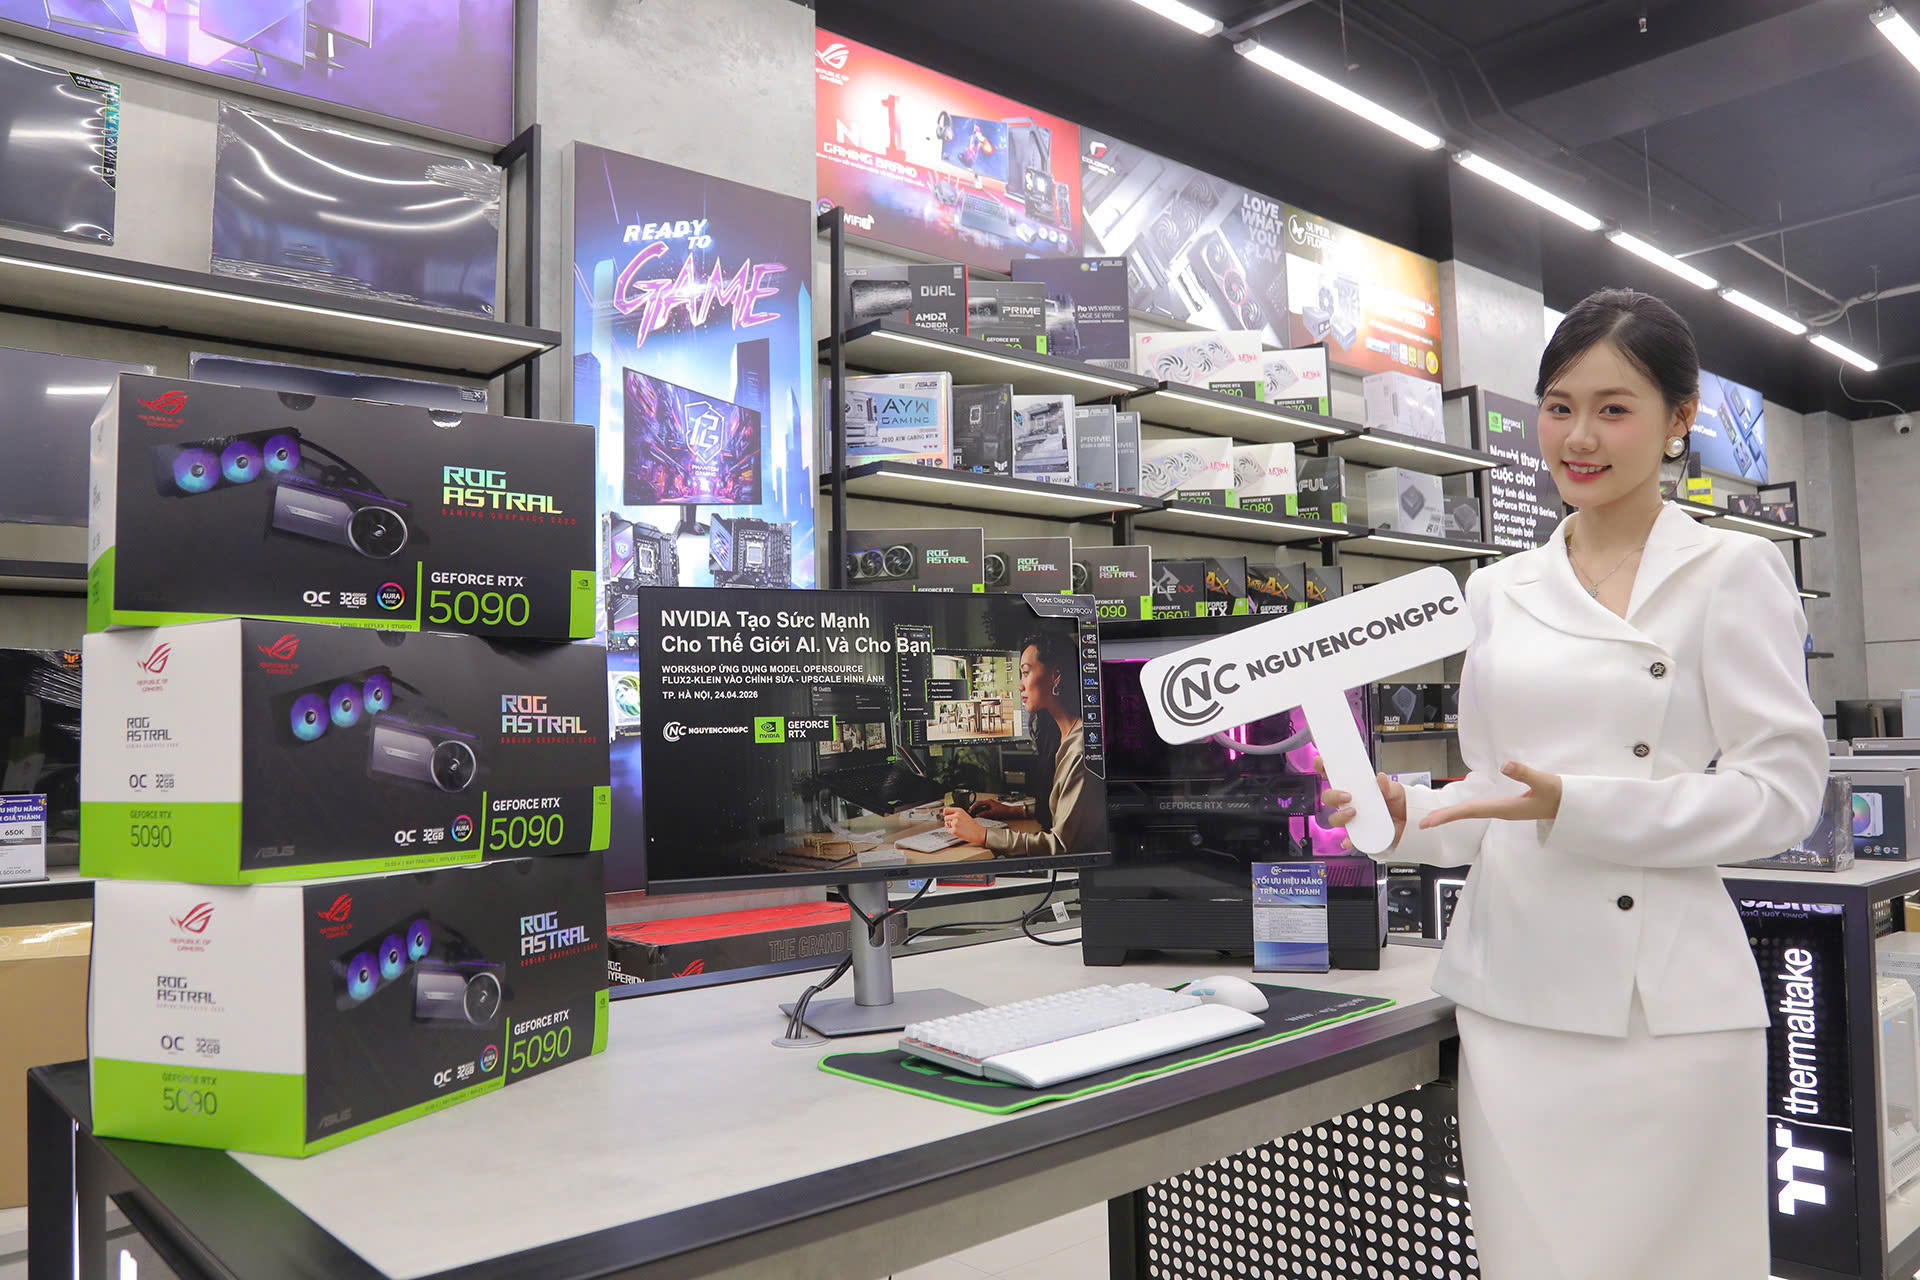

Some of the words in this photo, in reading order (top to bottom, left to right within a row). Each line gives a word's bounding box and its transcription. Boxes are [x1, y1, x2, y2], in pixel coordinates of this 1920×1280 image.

[823, 142, 873, 166] GAMING
[876, 156, 918, 179] BRAND
[1243, 193, 1279, 219] LOVE
[1240, 208, 1284, 235] WHAT
[623, 219, 708, 243] READY
[1249, 225, 1278, 247] YOU
[1305, 221, 1330, 239] SUPER
[687, 235, 712, 250] TO
[1246, 240, 1282, 264] PLAY
[613, 241, 788, 349] GAME
[920, 285, 956, 297] DUAL
[915, 313, 938, 322] AMD
[1002, 306, 1041, 315] PRIME
[882, 398, 929, 414] AYW
[882, 417, 930, 425] GAMING
[1080, 435, 1111, 443] PRIME
[1520, 452, 1540, 472] thay
[443, 465, 507, 490] ROG
[1491, 467, 1514, 485] cuộc
[1515, 470, 1536, 487] chơi
[442, 486, 564, 515] ASTRAL
[1492, 497, 1518, 511] GeForce
[1518, 502, 1531, 513] RTX
[442, 508, 484, 519] GAMING
[491, 511, 544, 523] GRAPHICS
[550, 516, 577, 526] CARD
[926, 549, 949, 557] ROG
[926, 556, 969, 565] ASTRAL
[1017, 557, 1039, 565] ROG
[1017, 564, 1058, 572] ASTRAL
[431, 572, 494, 588] GEFORCE
[498, 574, 524, 587] RTX
[303, 590, 331, 605] OC
[339, 592, 367, 606] 32GB
[1035, 596, 1052, 604] ProArt
[1053, 597, 1075, 605] Display
[428, 590, 530, 627] 5090
[1260, 604, 1288, 612] GEFORCE
[661, 610, 732, 628] NVIDIA
[737, 611, 771, 632] Tạo
[776, 611, 815, 628] Sức
[820, 612, 870, 632] Mạnh
[661, 636, 702, 653] Cho
[707, 633, 744, 653] Thế
[749, 634, 790, 653] Giới
[796, 637, 821, 653] AI.
[826, 635, 850, 653] Và
[854, 636, 891, 653] Cho
[896, 637, 936, 657] Bạn.
[1245, 596, 1459, 682] NGUYENCONGPC
[661, 665, 717, 674] WORKSHOP
[719, 663, 740, 674] ỨNG
[742, 665, 768, 676] DỤNG
[769, 665, 801, 673] MODEL
[803, 665, 863, 673] OPENSOURCE
[662, 675, 722, 684] FLUX2-KLEIN
[723, 673, 743, 684] VÀO
[745, 673, 773, 684] CHỈNH
[775, 673, 794, 684] SỬA
[801, 675, 842, 684] UPSCALE
[843, 673, 865, 683] HÌNH
[866, 673, 885, 683] ẢNH
[662, 691, 676, 700] TP.
[678, 689, 692, 700] HÀ
[694, 689, 714, 701] NỘI,
[715, 691, 758, 699] 24.04.2026
[501, 694, 548, 714] ROG
[126, 717, 150, 729] ROG
[501, 716, 588, 734] ASTRAL
[688, 726, 748, 735] NGUYENCONGPC
[787, 720, 829, 730] GEFORCE
[126, 729, 173, 742] ASTRAL
[788, 730, 807, 738] RTX
[129, 774, 147, 789] OC
[492, 798, 538, 812] GEFORCE
[541, 797, 560, 810] RTX
[1159, 801, 1202, 810] GEFORCE
[1204, 801, 1223, 810] RTX
[130, 810, 157, 820] GEFORCE
[157, 810, 172, 820] RTX
[5, 829, 24, 837] 650K
[130, 824, 173, 849] 5090
[394, 829, 417, 845] OC
[489, 813, 563, 851] 5090
[256, 845, 296, 859] ASUS
[1282, 877, 1300, 887] HIỆU
[1301, 876, 1323, 885] NĂNG
[1260, 886, 1279, 895] TRÊN
[1280, 886, 1293, 895] GIÁ
[1295, 887, 1321, 896] THÀNH
[520, 910, 558, 936] ROG
[520, 925, 591, 956] ASTRAL
[768, 938, 796, 962] THE
[798, 931, 844, 958] GRAND
[157, 975, 188, 989] ROG
[156, 989, 217, 1005] ASTRAL
[514, 1016, 552, 1036] GEFORCE
[553, 1009, 569, 1025] RTX
[1777, 947, 1819, 1115] thermaltake
[161, 1035, 185, 1051] OC
[511, 1026, 572, 1074] 5090
[433, 1068, 453, 1086] OC
[162, 1087, 218, 1116] 5090
